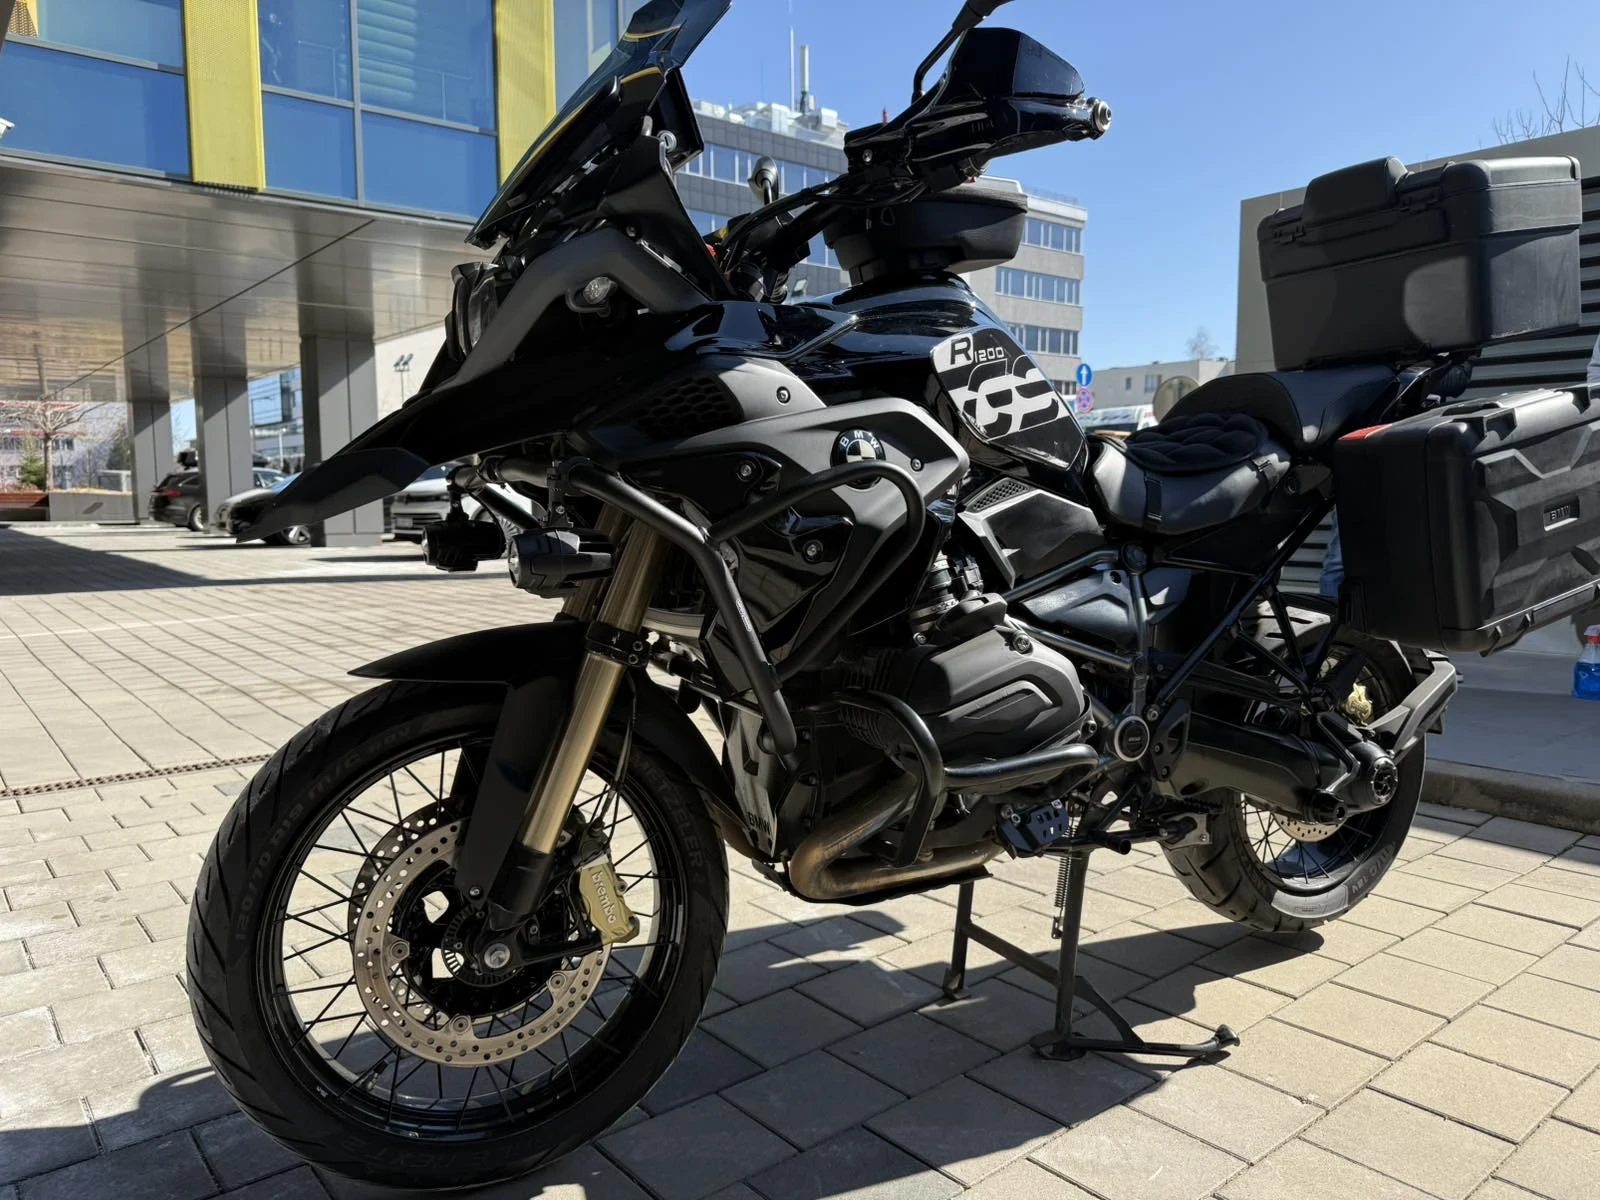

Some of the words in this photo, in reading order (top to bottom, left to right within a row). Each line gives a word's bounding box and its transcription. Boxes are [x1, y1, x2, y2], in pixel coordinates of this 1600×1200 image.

[950, 336, 972, 365] R
[974, 347, 1005, 363] 1200
[840, 430, 879, 449] BMW
[634, 755, 704, 869] METZELER
[748, 812, 772, 835] BMW
[592, 871, 617, 924] brembo
